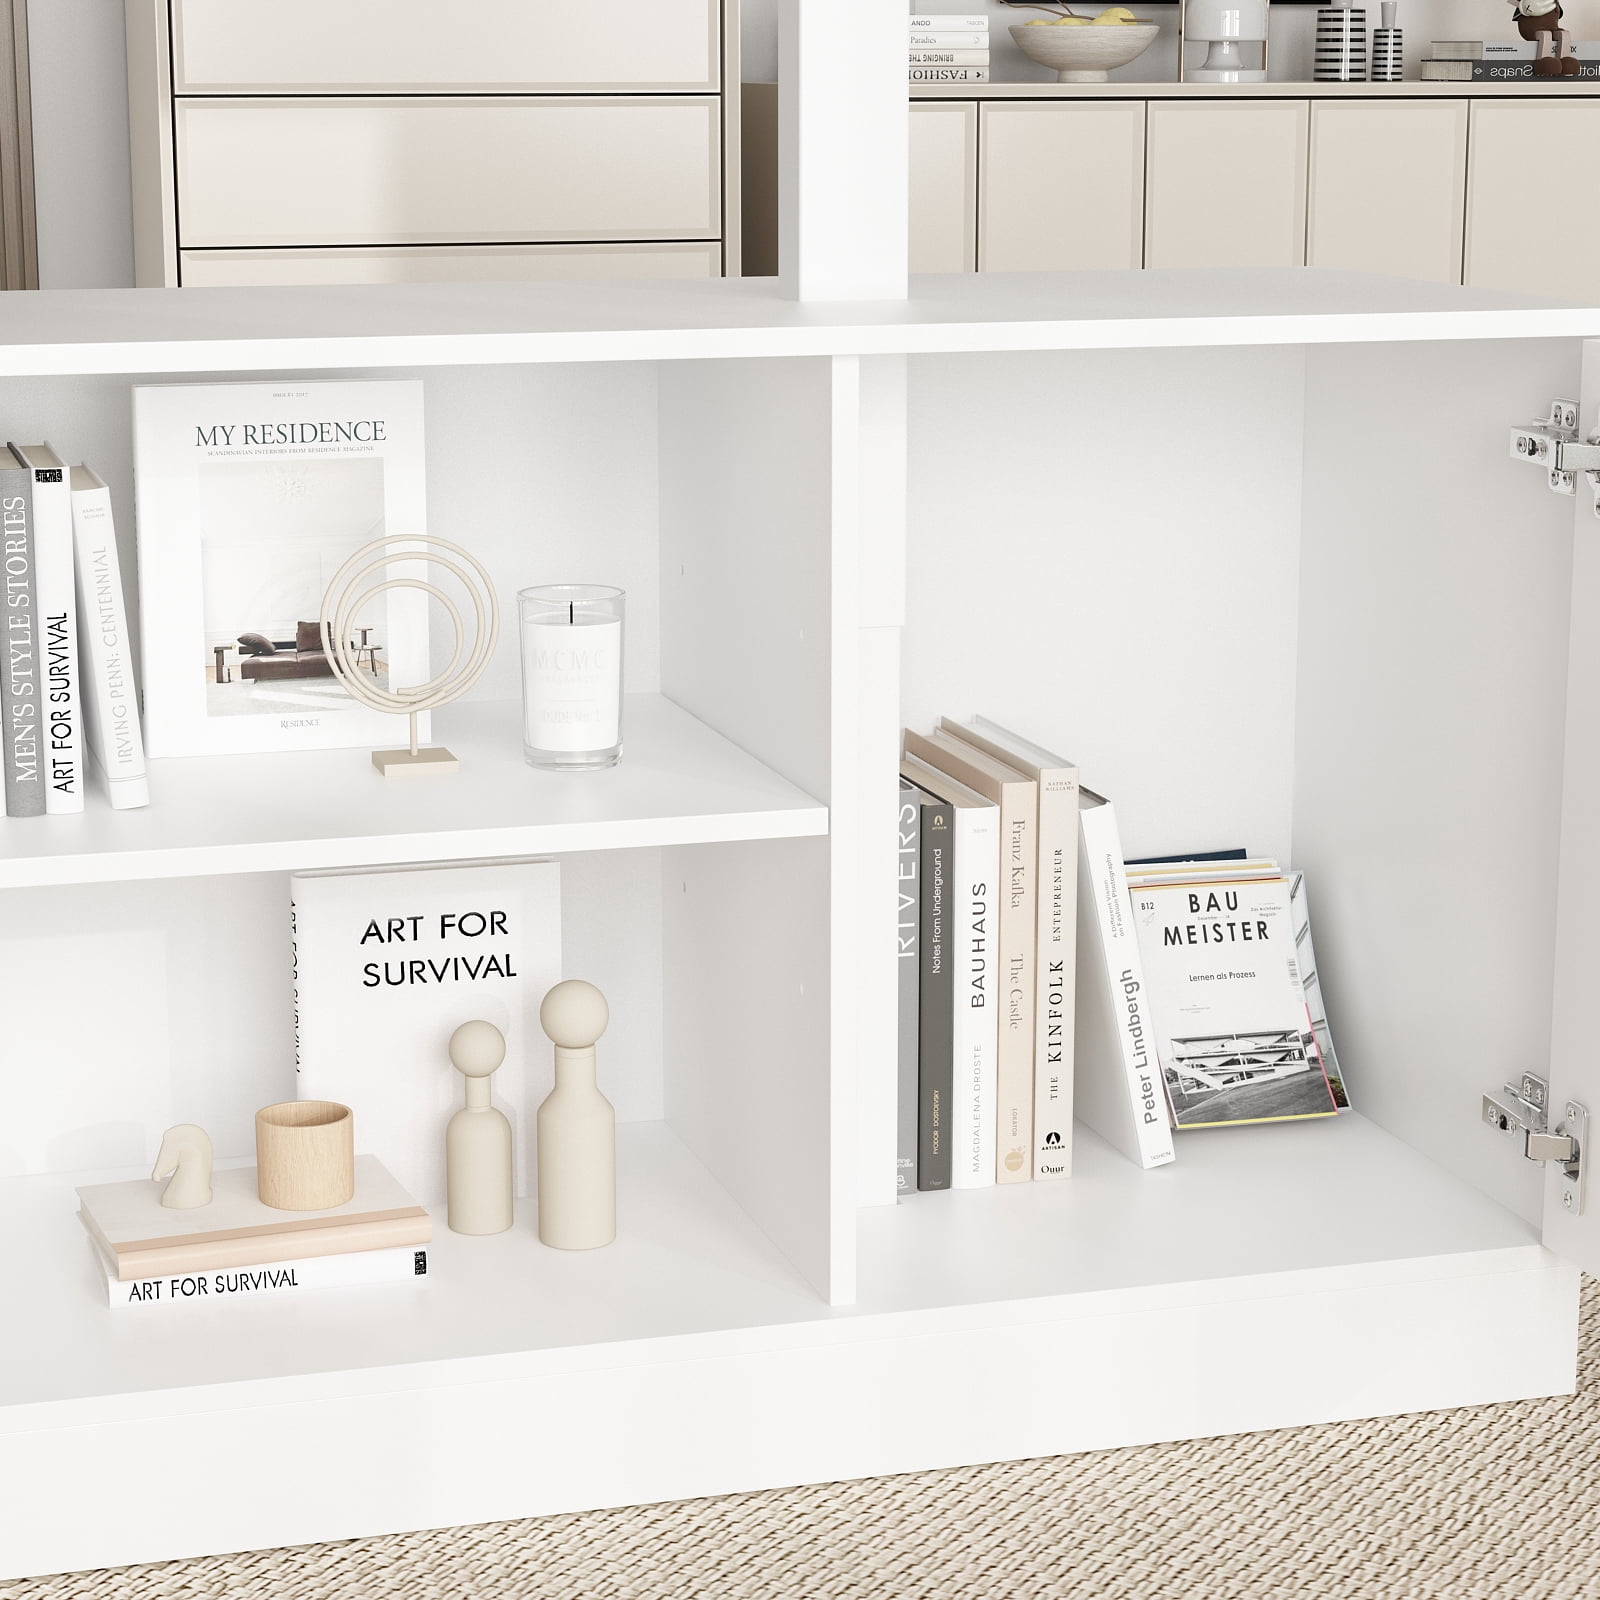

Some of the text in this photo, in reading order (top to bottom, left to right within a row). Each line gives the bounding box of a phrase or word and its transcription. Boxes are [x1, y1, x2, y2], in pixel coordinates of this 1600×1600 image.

[908, 70, 968, 80] FASHIO
[923, 54, 954, 62] BRINGING
[195, 420, 387, 447] MY RESIDENCE
[207, 449, 253, 457] SCANDINAVIAN
[2, 495, 31, 608] STORIES
[91, 545, 118, 648] CENTENNIAL
[9, 613, 33, 696] STYLE
[105, 652, 125, 698] PENN:
[46, 612, 75, 794] ART FOR SURVIVAL
[112, 704, 133, 764] IRVING
[1011, 819, 1026, 909] Franz Kafka
[931, 848, 944, 974] Notes From Underground
[1103, 879, 1112, 902] Vision
[1105, 853, 1125, 937] on Fashion Photography
[1140, 901, 1155, 911] B12
[1188, 891, 1239, 913] BAU
[360, 910, 509, 945] ART FOR
[1107, 902, 1117, 932] Different
[1163, 920, 1270, 946] MEISTER
[971, 882, 987, 1009] BAUHAUS
[363, 953, 518, 988] SURVIVAL
[1009, 953, 1024, 1030] The Castle
[1047, 848, 1064, 1101] THE KINFOLK ENTEPRENEUR
[1189, 971, 1256, 982] Lernen als Prozess
[1119, 968, 1157, 1124] Peter Lindbergh
[972, 1044, 982, 1173] MAGDALENA DROSTE
[128, 1268, 299, 1302] ART FOR SURVIVAL
